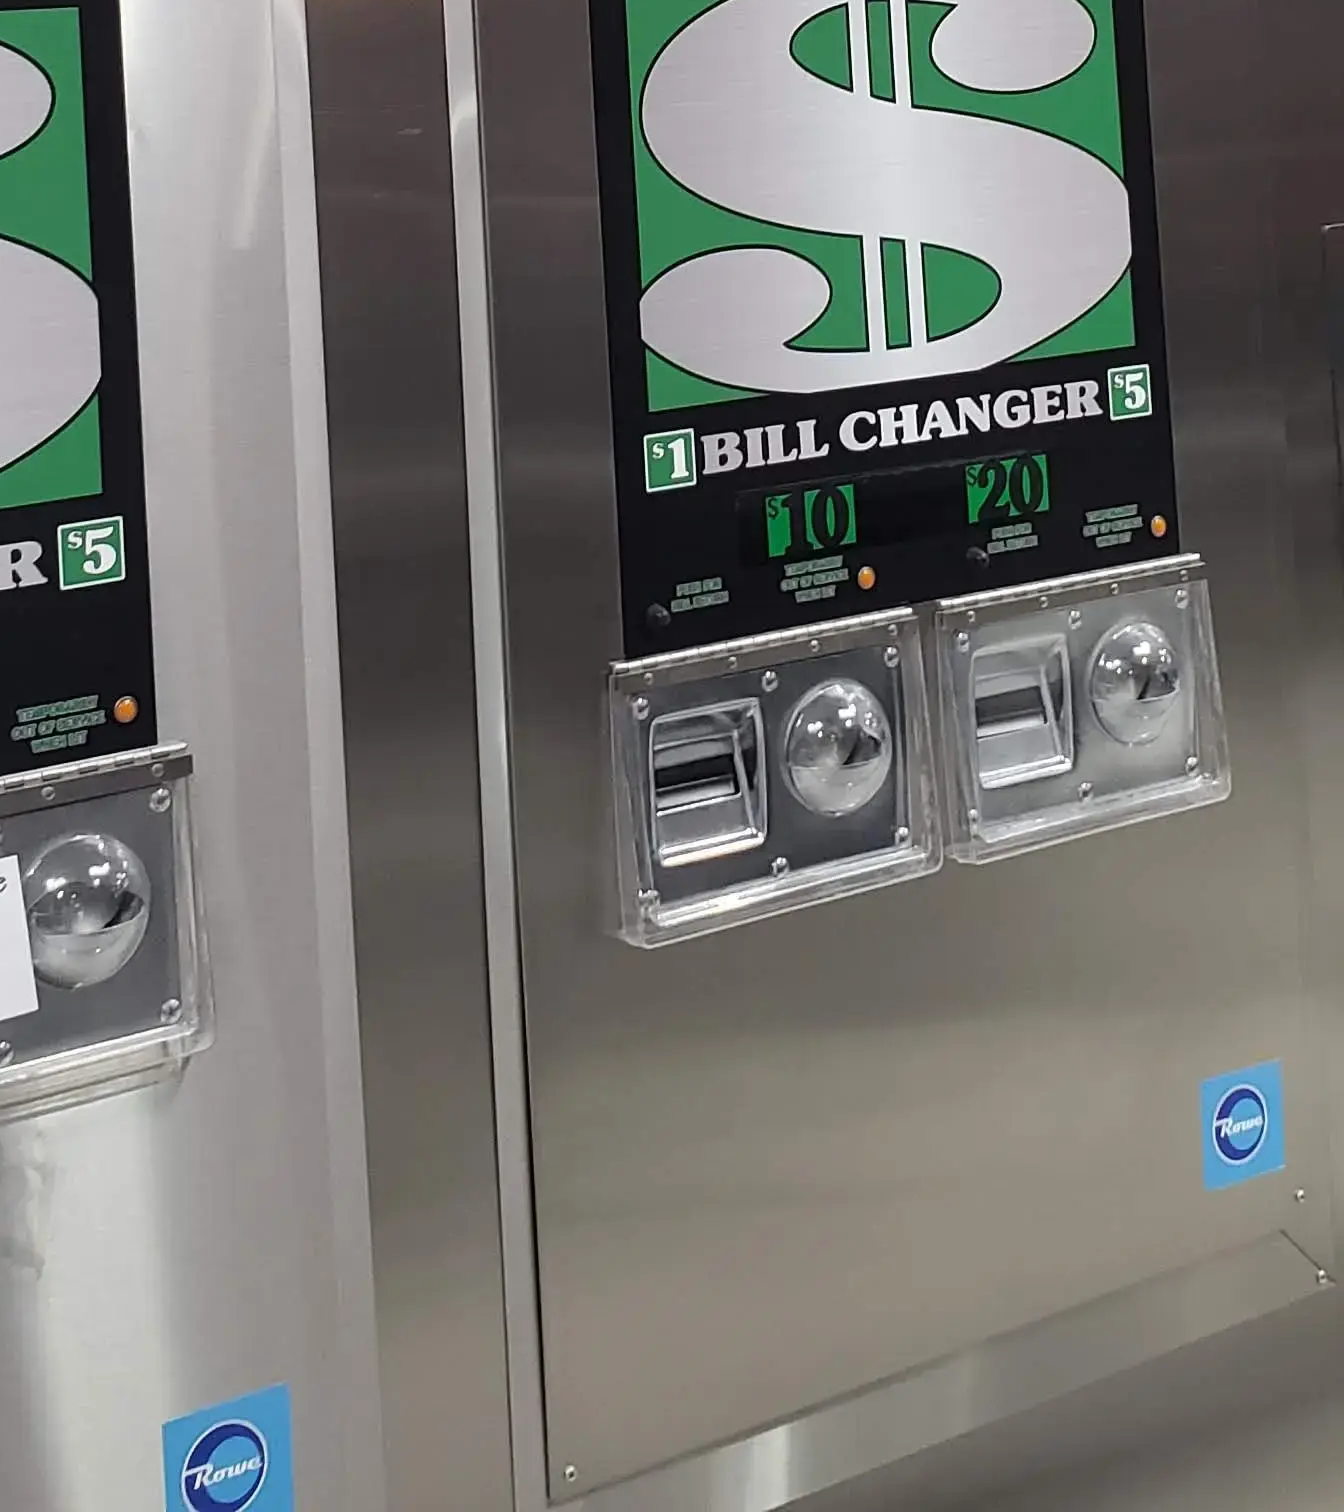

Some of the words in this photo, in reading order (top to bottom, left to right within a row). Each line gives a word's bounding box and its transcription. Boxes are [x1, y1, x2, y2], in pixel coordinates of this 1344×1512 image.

[650, 440, 691, 482] $1
[700, 417, 829, 475] BILL
[838, 378, 1105, 452] CHANGER
[1113, 370, 1147, 411] $5
[765, 486, 852, 553] $10
[966, 456, 1046, 521] $20
[66, 526, 118, 577] $5
[183, 1455, 264, 1491] Rowe
